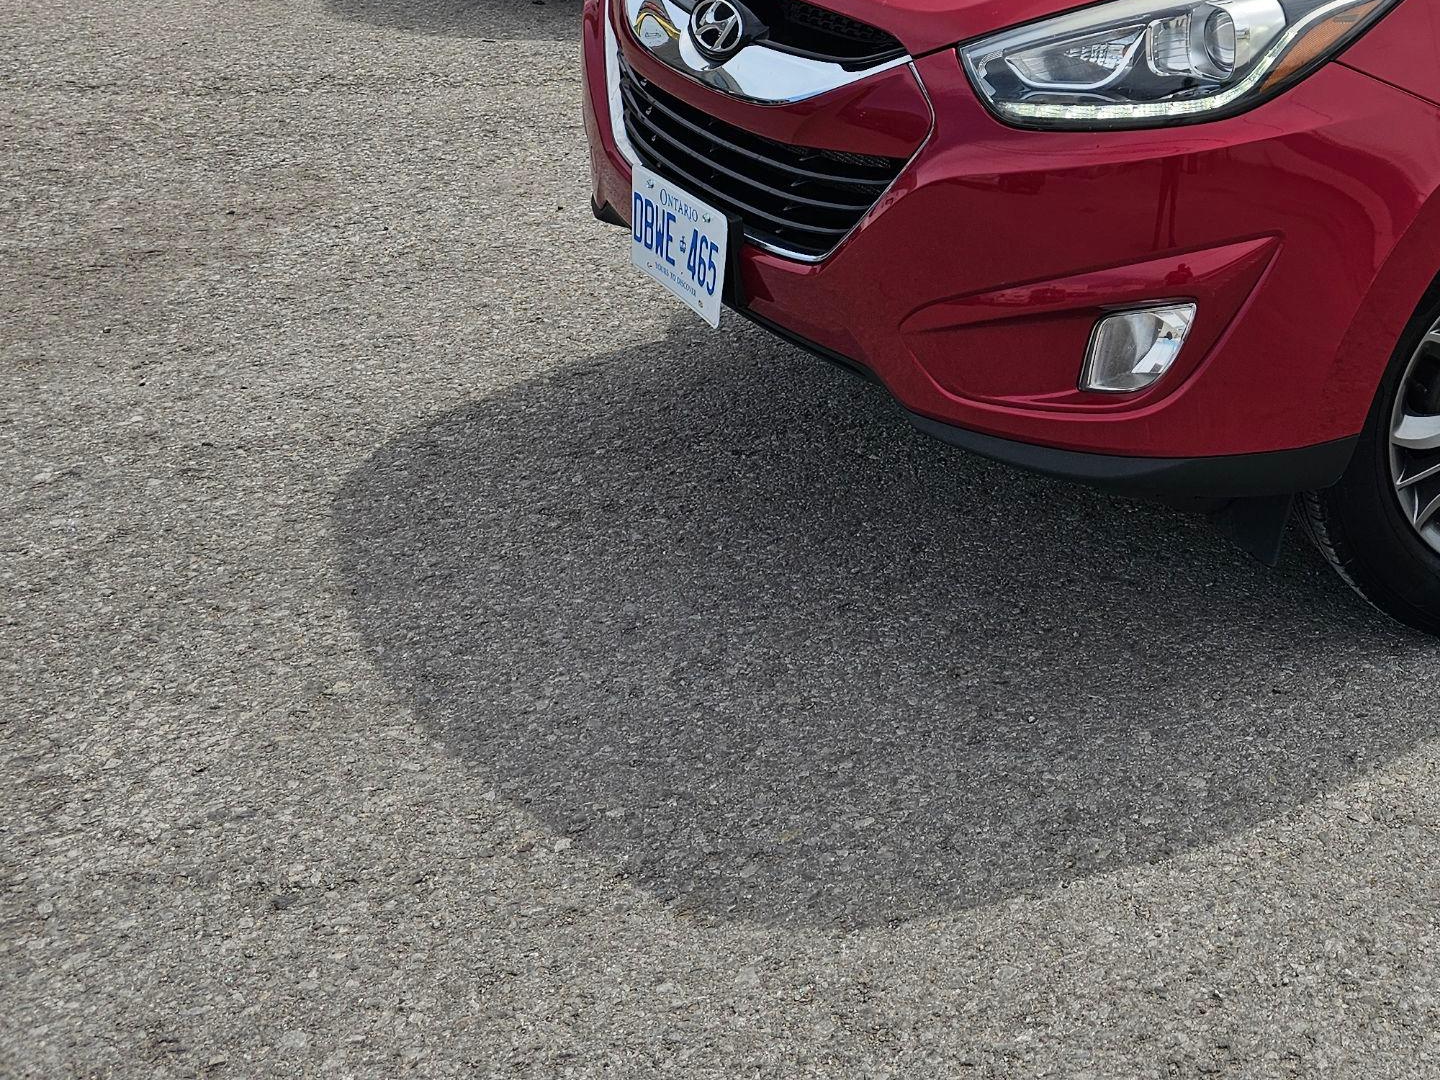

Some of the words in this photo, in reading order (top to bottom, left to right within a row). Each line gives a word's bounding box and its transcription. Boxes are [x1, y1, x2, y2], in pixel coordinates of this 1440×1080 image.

[660, 188, 699, 223] ONTARIO
[633, 191, 677, 267] DBWE
[686, 228, 719, 296] 465
[676, 276, 697, 297] DISCOVER
